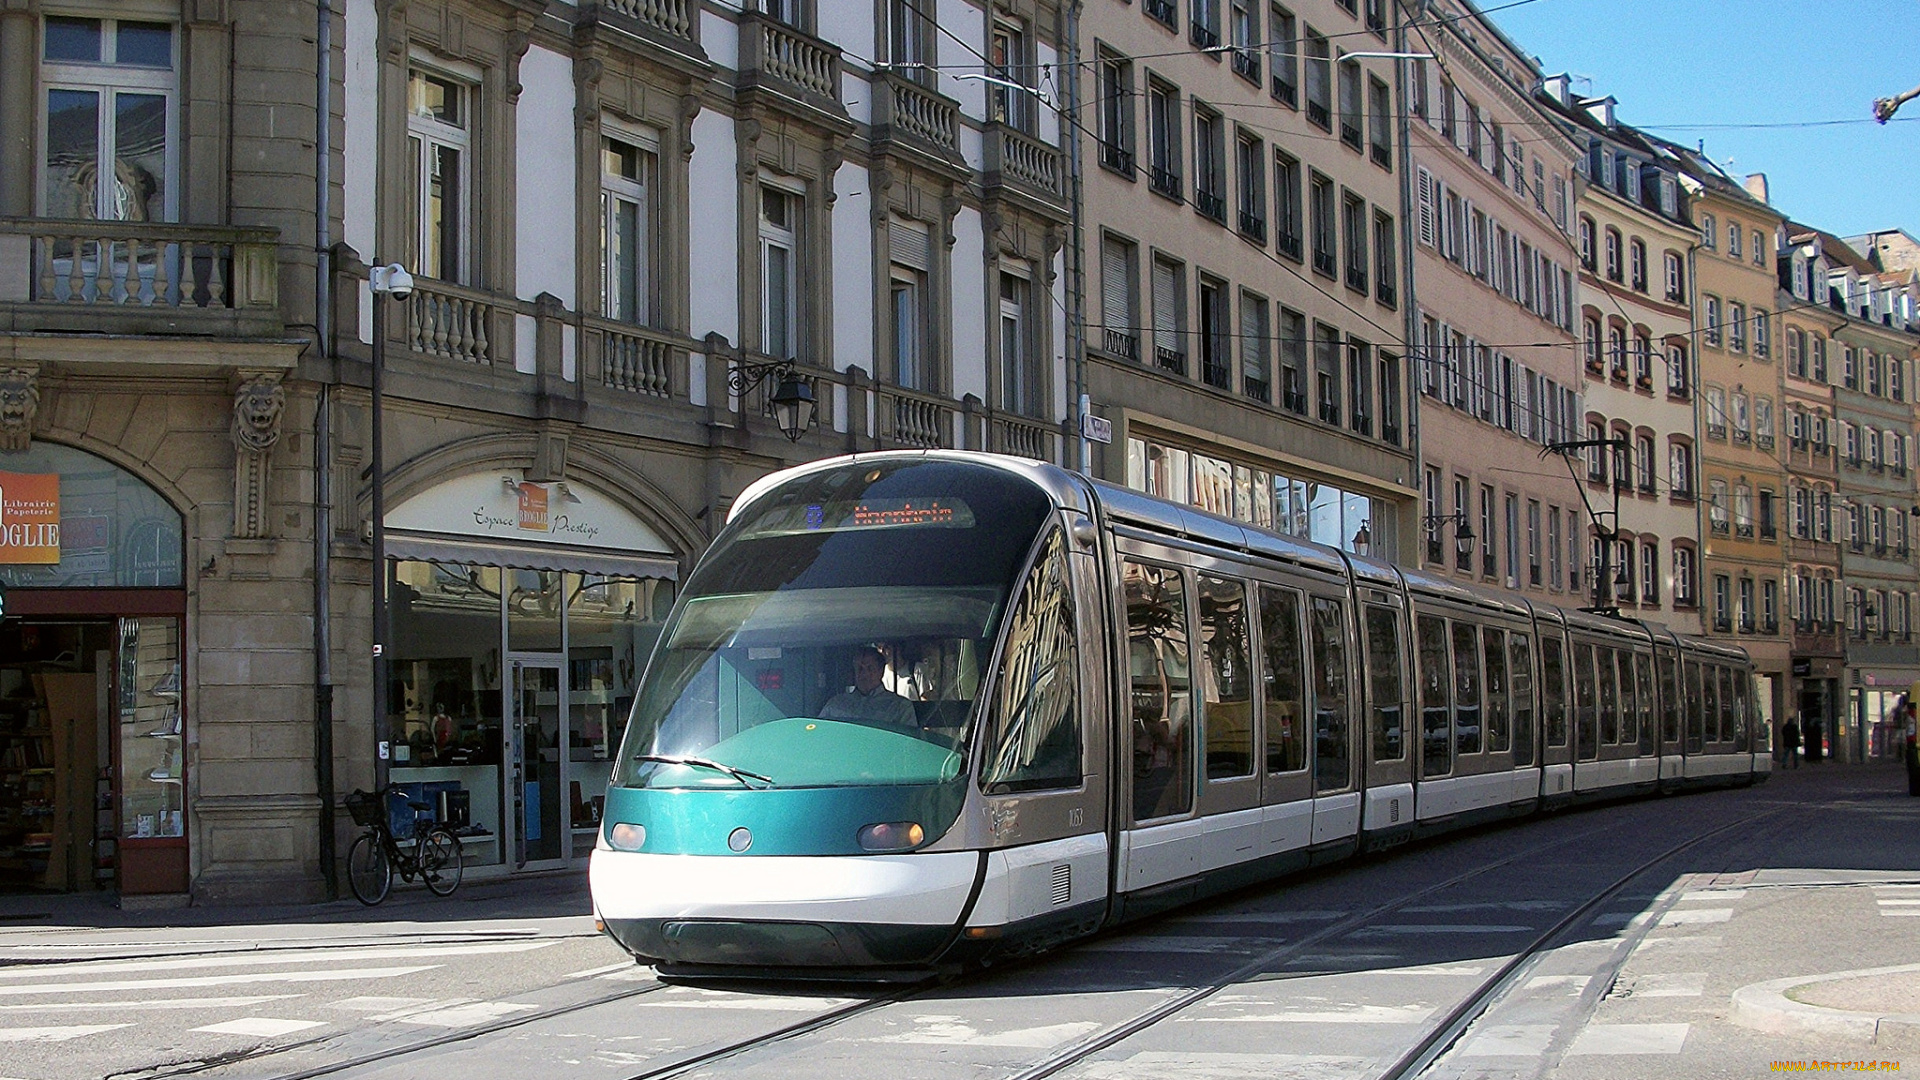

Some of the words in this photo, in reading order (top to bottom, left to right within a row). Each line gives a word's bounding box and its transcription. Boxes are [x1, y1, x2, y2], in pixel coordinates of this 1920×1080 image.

[6, 508, 54, 516] Papeterie
[473, 506, 514, 530] Espace
[551, 515, 600, 539] Prestige
